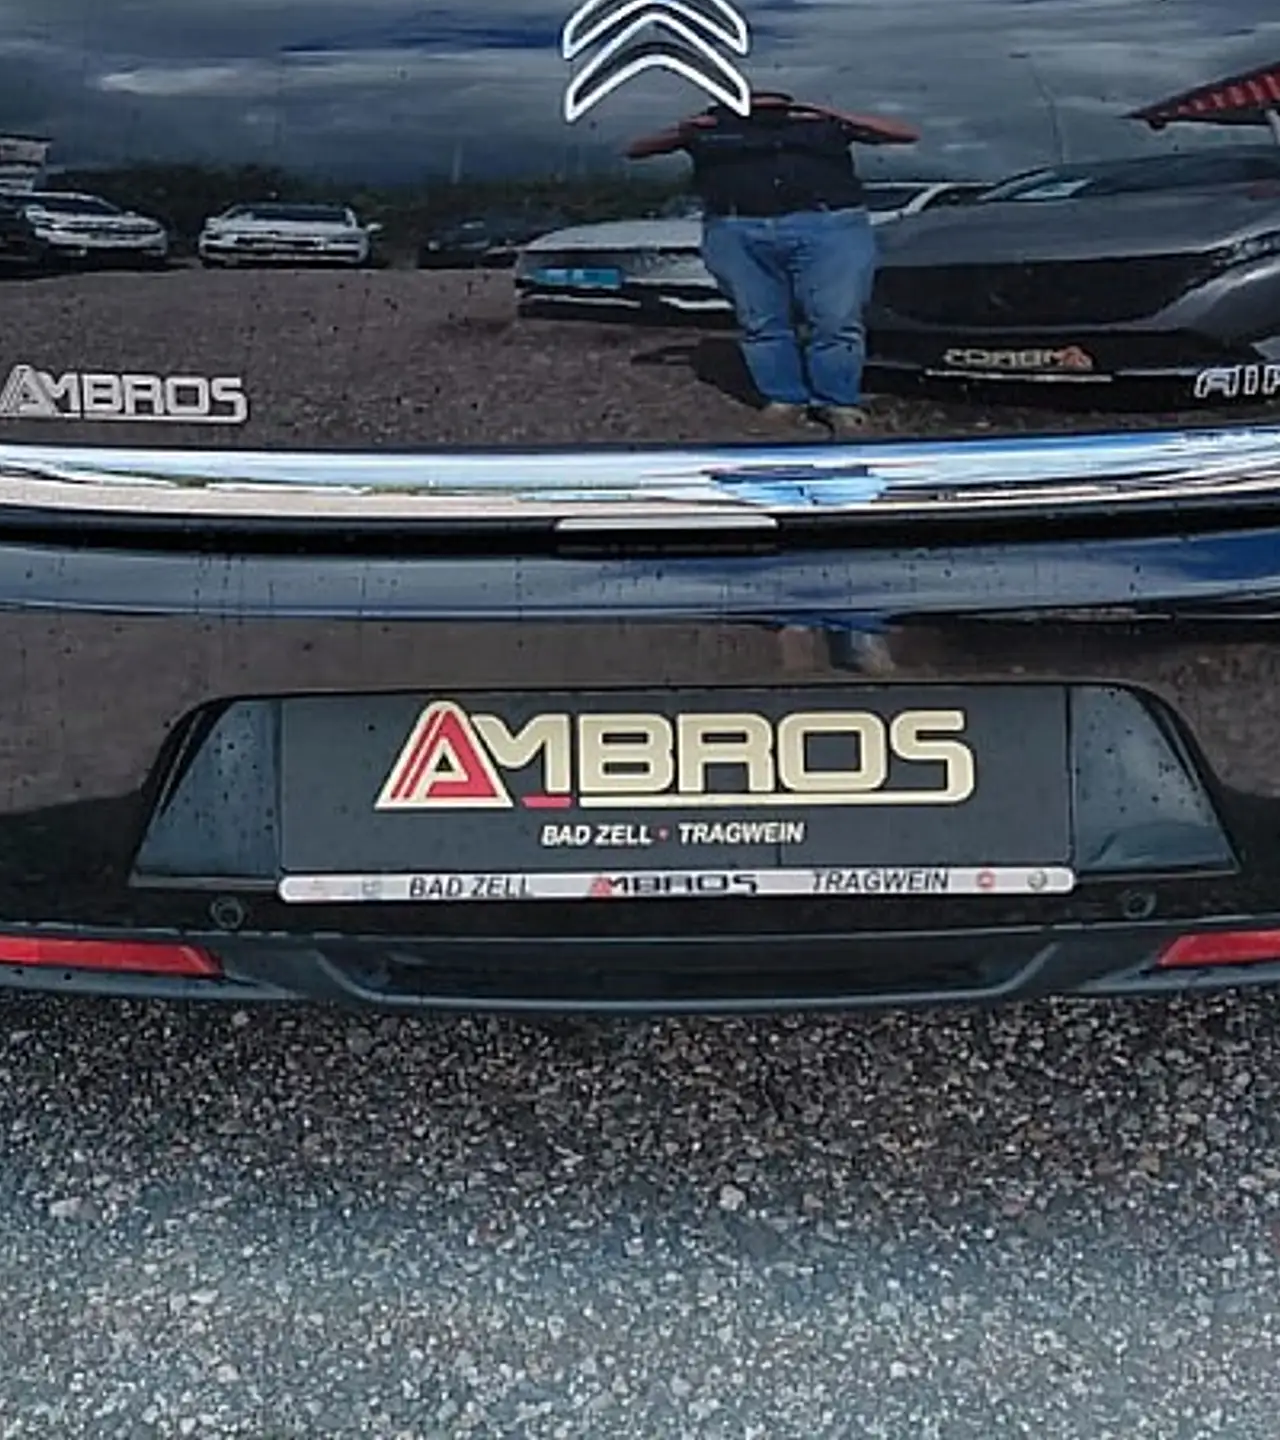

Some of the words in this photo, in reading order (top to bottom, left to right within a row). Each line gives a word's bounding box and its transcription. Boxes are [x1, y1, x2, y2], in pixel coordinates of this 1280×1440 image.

[373, 699, 976, 809] AMBROS
[541, 823, 592, 846] BAD
[594, 823, 653, 845] ZELL
[678, 821, 805, 844] TRAGWEIN
[409, 876, 463, 898] BAD
[469, 875, 532, 897] ZELL
[590, 873, 759, 898] AMBROS
[812, 870, 950, 892] TRAGWEIN
